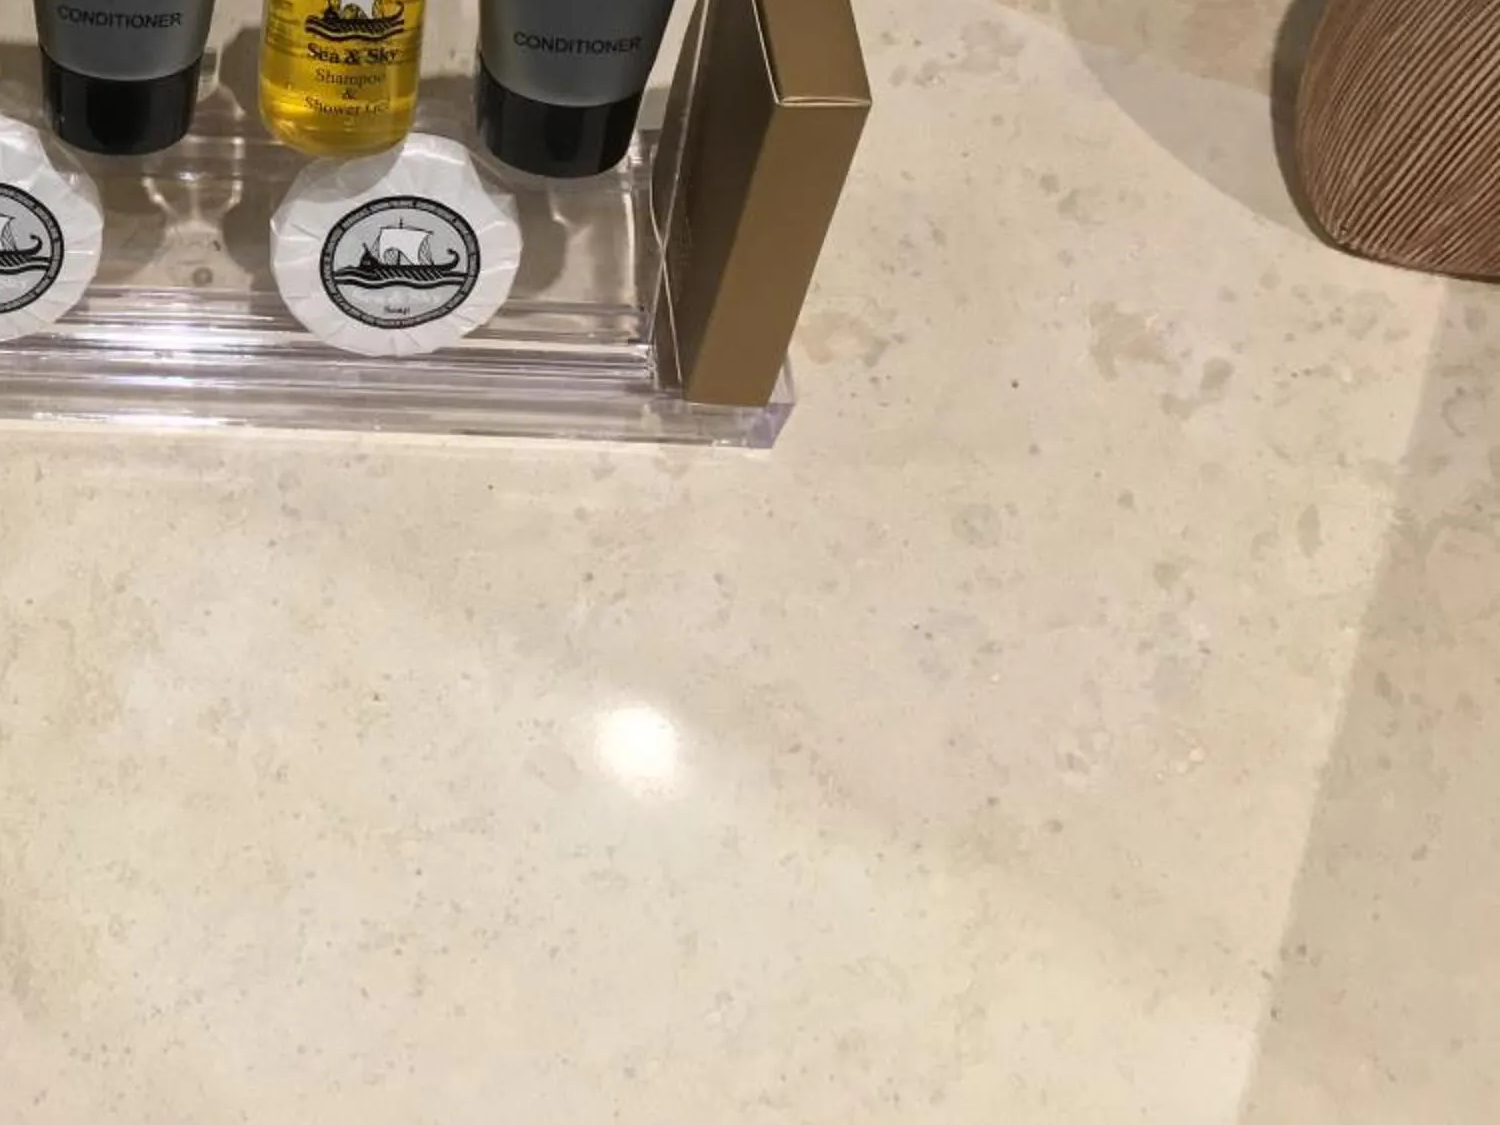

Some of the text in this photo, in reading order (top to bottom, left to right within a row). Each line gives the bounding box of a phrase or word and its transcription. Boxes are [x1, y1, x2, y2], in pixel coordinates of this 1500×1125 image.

[57, 4, 183, 30] CONDITIONER
[308, 42, 398, 65] Sea & Sky
[513, 31, 642, 55] CONDITIONER
